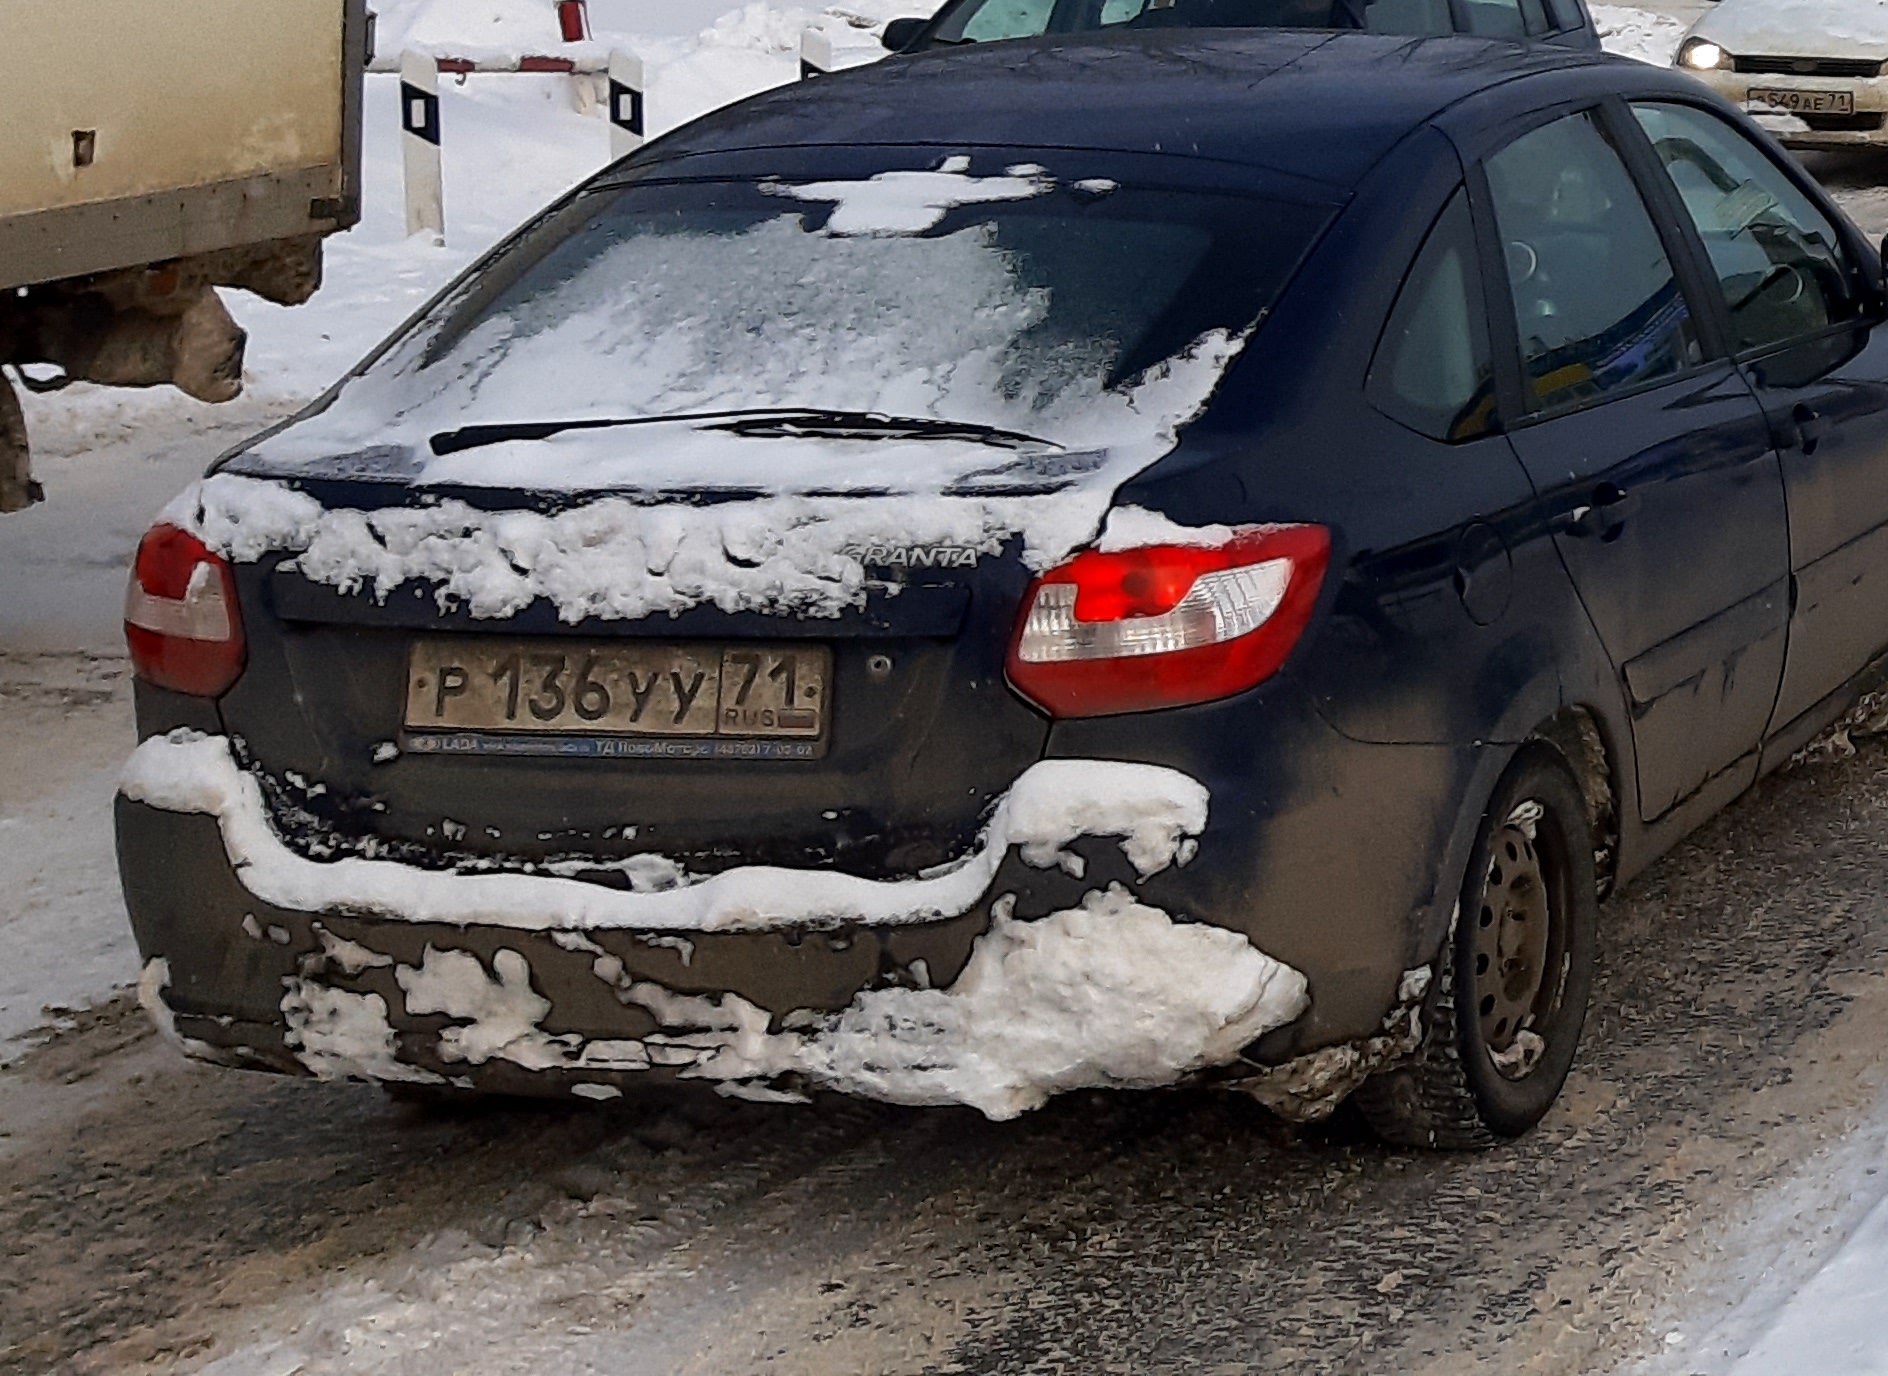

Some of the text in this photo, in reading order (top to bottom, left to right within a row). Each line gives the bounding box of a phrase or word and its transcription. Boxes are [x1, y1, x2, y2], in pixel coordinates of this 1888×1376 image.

[1827, 93, 1848, 109] 71
[729, 652, 797, 707] 71
[724, 707, 775, 728] RUS
[442, 737, 478, 752] LADA
